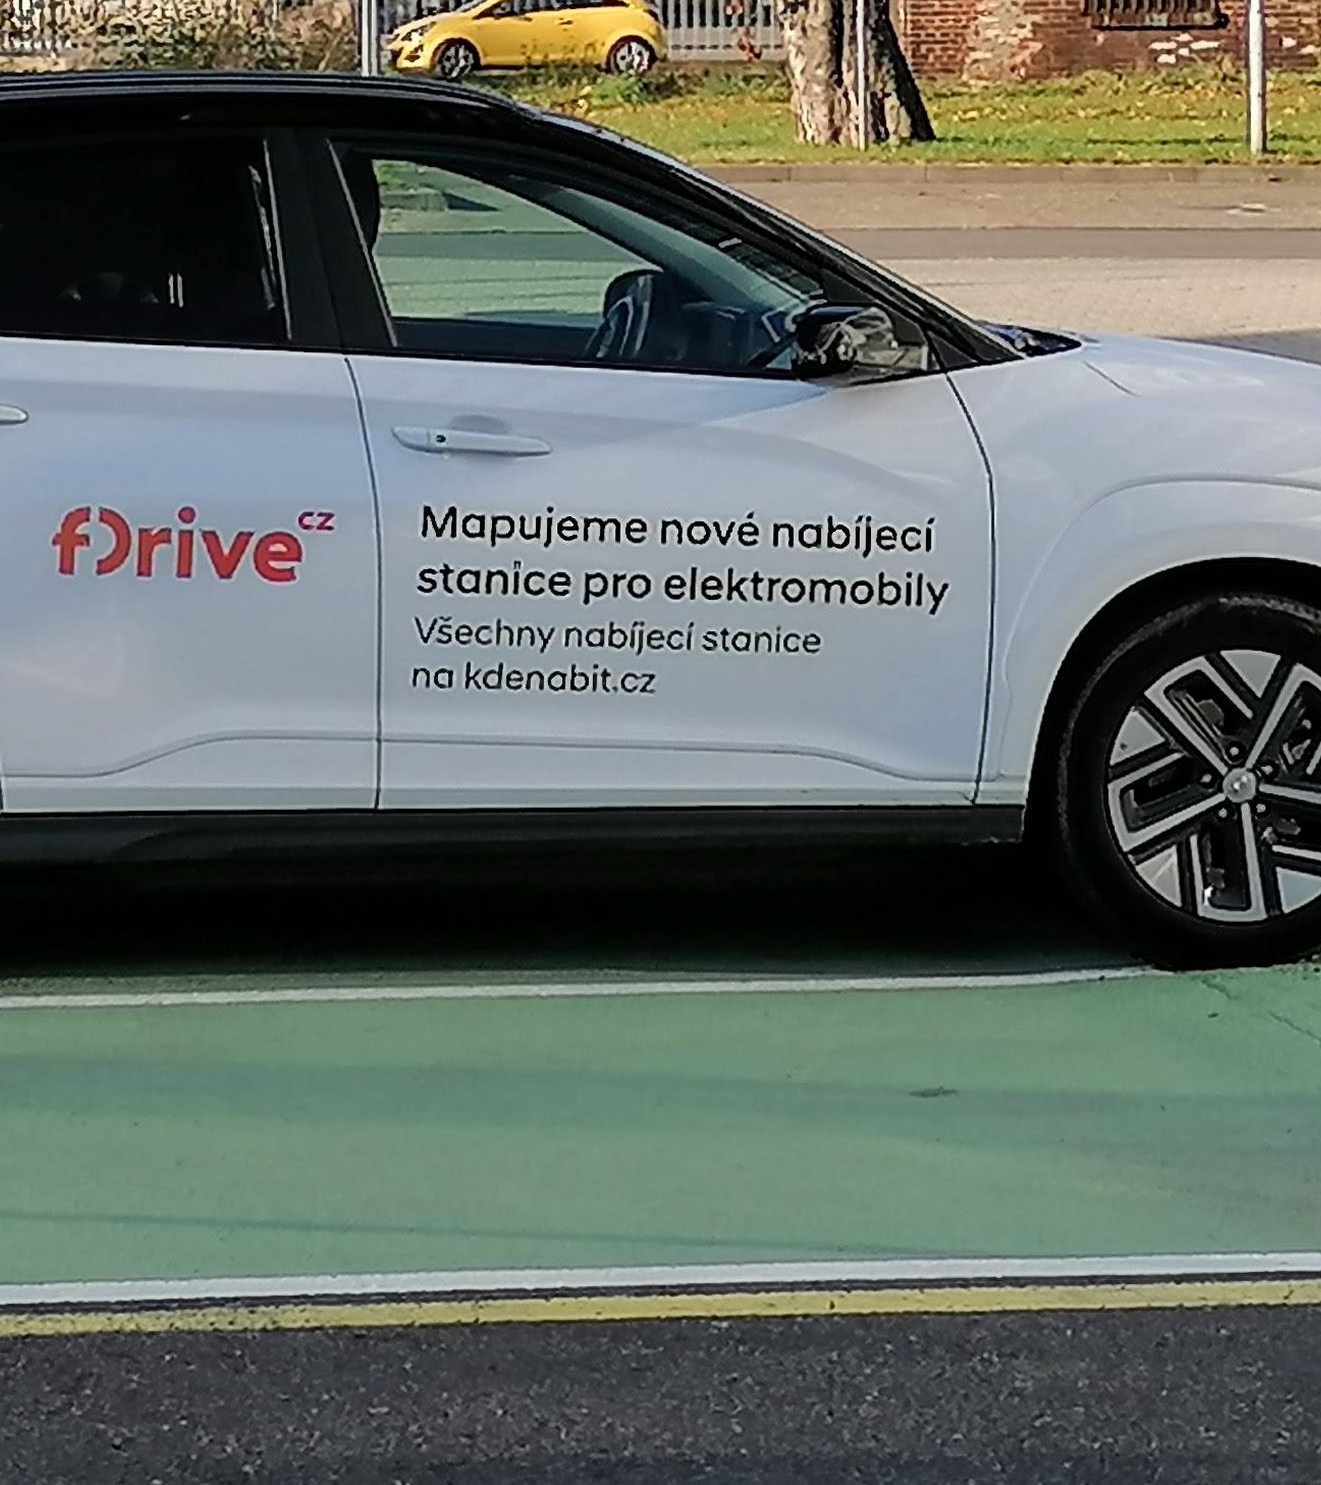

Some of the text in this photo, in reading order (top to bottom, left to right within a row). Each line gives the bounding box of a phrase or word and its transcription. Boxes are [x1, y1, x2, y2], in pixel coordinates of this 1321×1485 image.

[51, 505, 304, 584] fDrive
[421, 505, 936, 558] Mapujeme nové nabíjecí
[416, 560, 950, 616] stanice pro elektromobily
[414, 616, 823, 657] Všechny nabíjecí stanice
[411, 661, 657, 694] na kdenabit.cz
